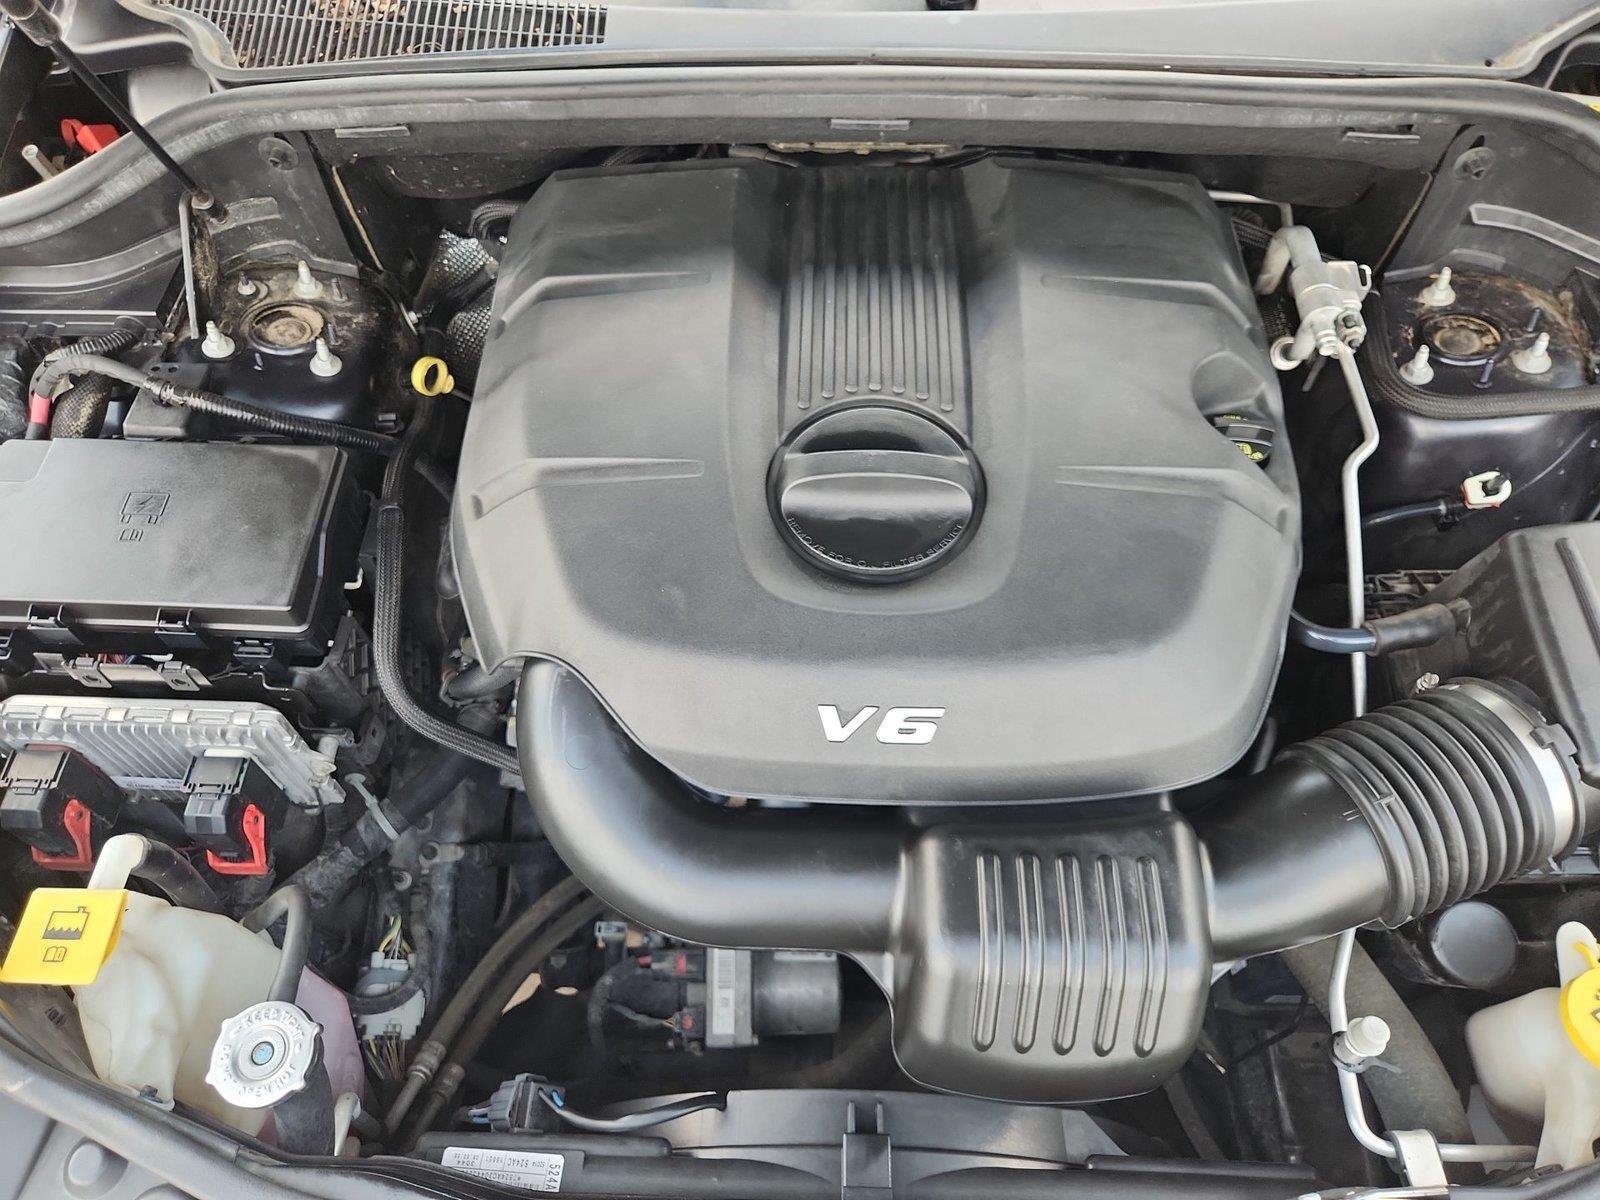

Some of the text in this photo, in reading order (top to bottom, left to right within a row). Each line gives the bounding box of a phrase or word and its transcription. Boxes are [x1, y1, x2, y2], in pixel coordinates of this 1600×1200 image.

[788, 517, 826, 552] REMOVE
[828, 551, 853, 564] FOR
[883, 554, 924, 568] FITER
[817, 703, 946, 745] V6
[247, 1008, 280, 1026] KEEP
[546, 1163, 561, 1191] 524A
